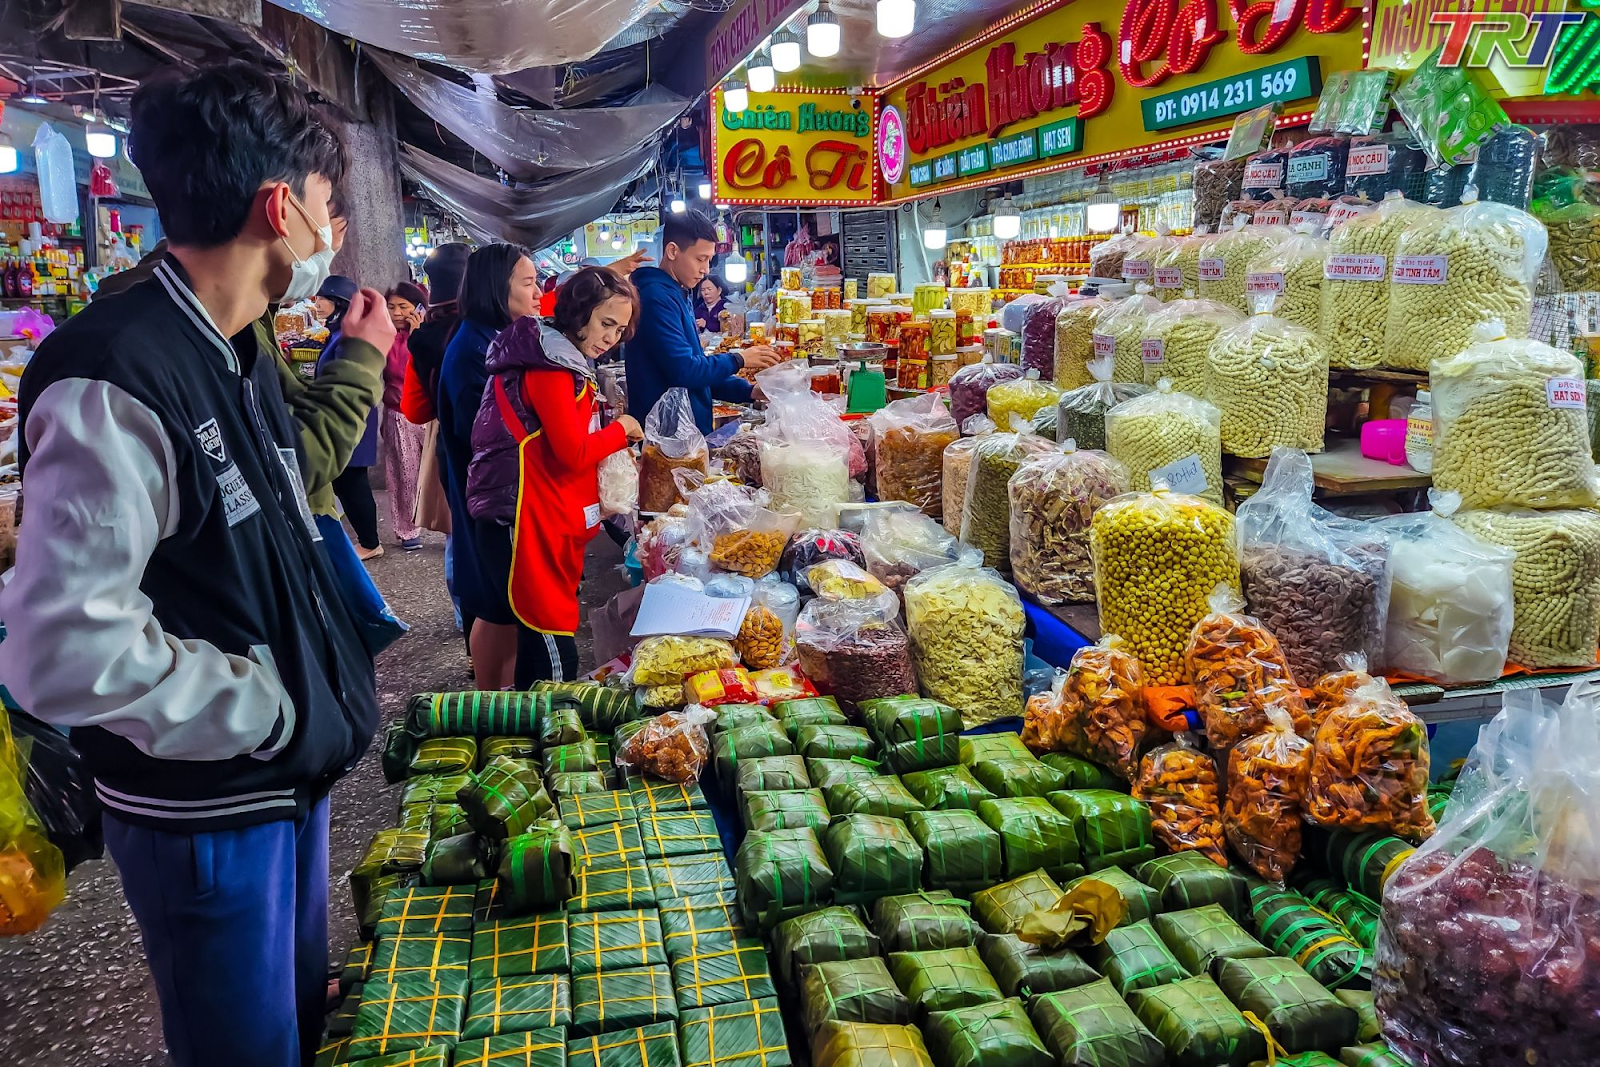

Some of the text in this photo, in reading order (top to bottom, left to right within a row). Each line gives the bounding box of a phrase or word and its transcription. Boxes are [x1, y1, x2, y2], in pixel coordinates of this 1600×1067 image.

[1180, 87, 1219, 117] 0914
[1224, 79, 1254, 108] 231
[1261, 67, 1297, 98] 569
[723, 138, 797, 190] Cô
[1043, 126, 1071, 154] HẠT SEN
